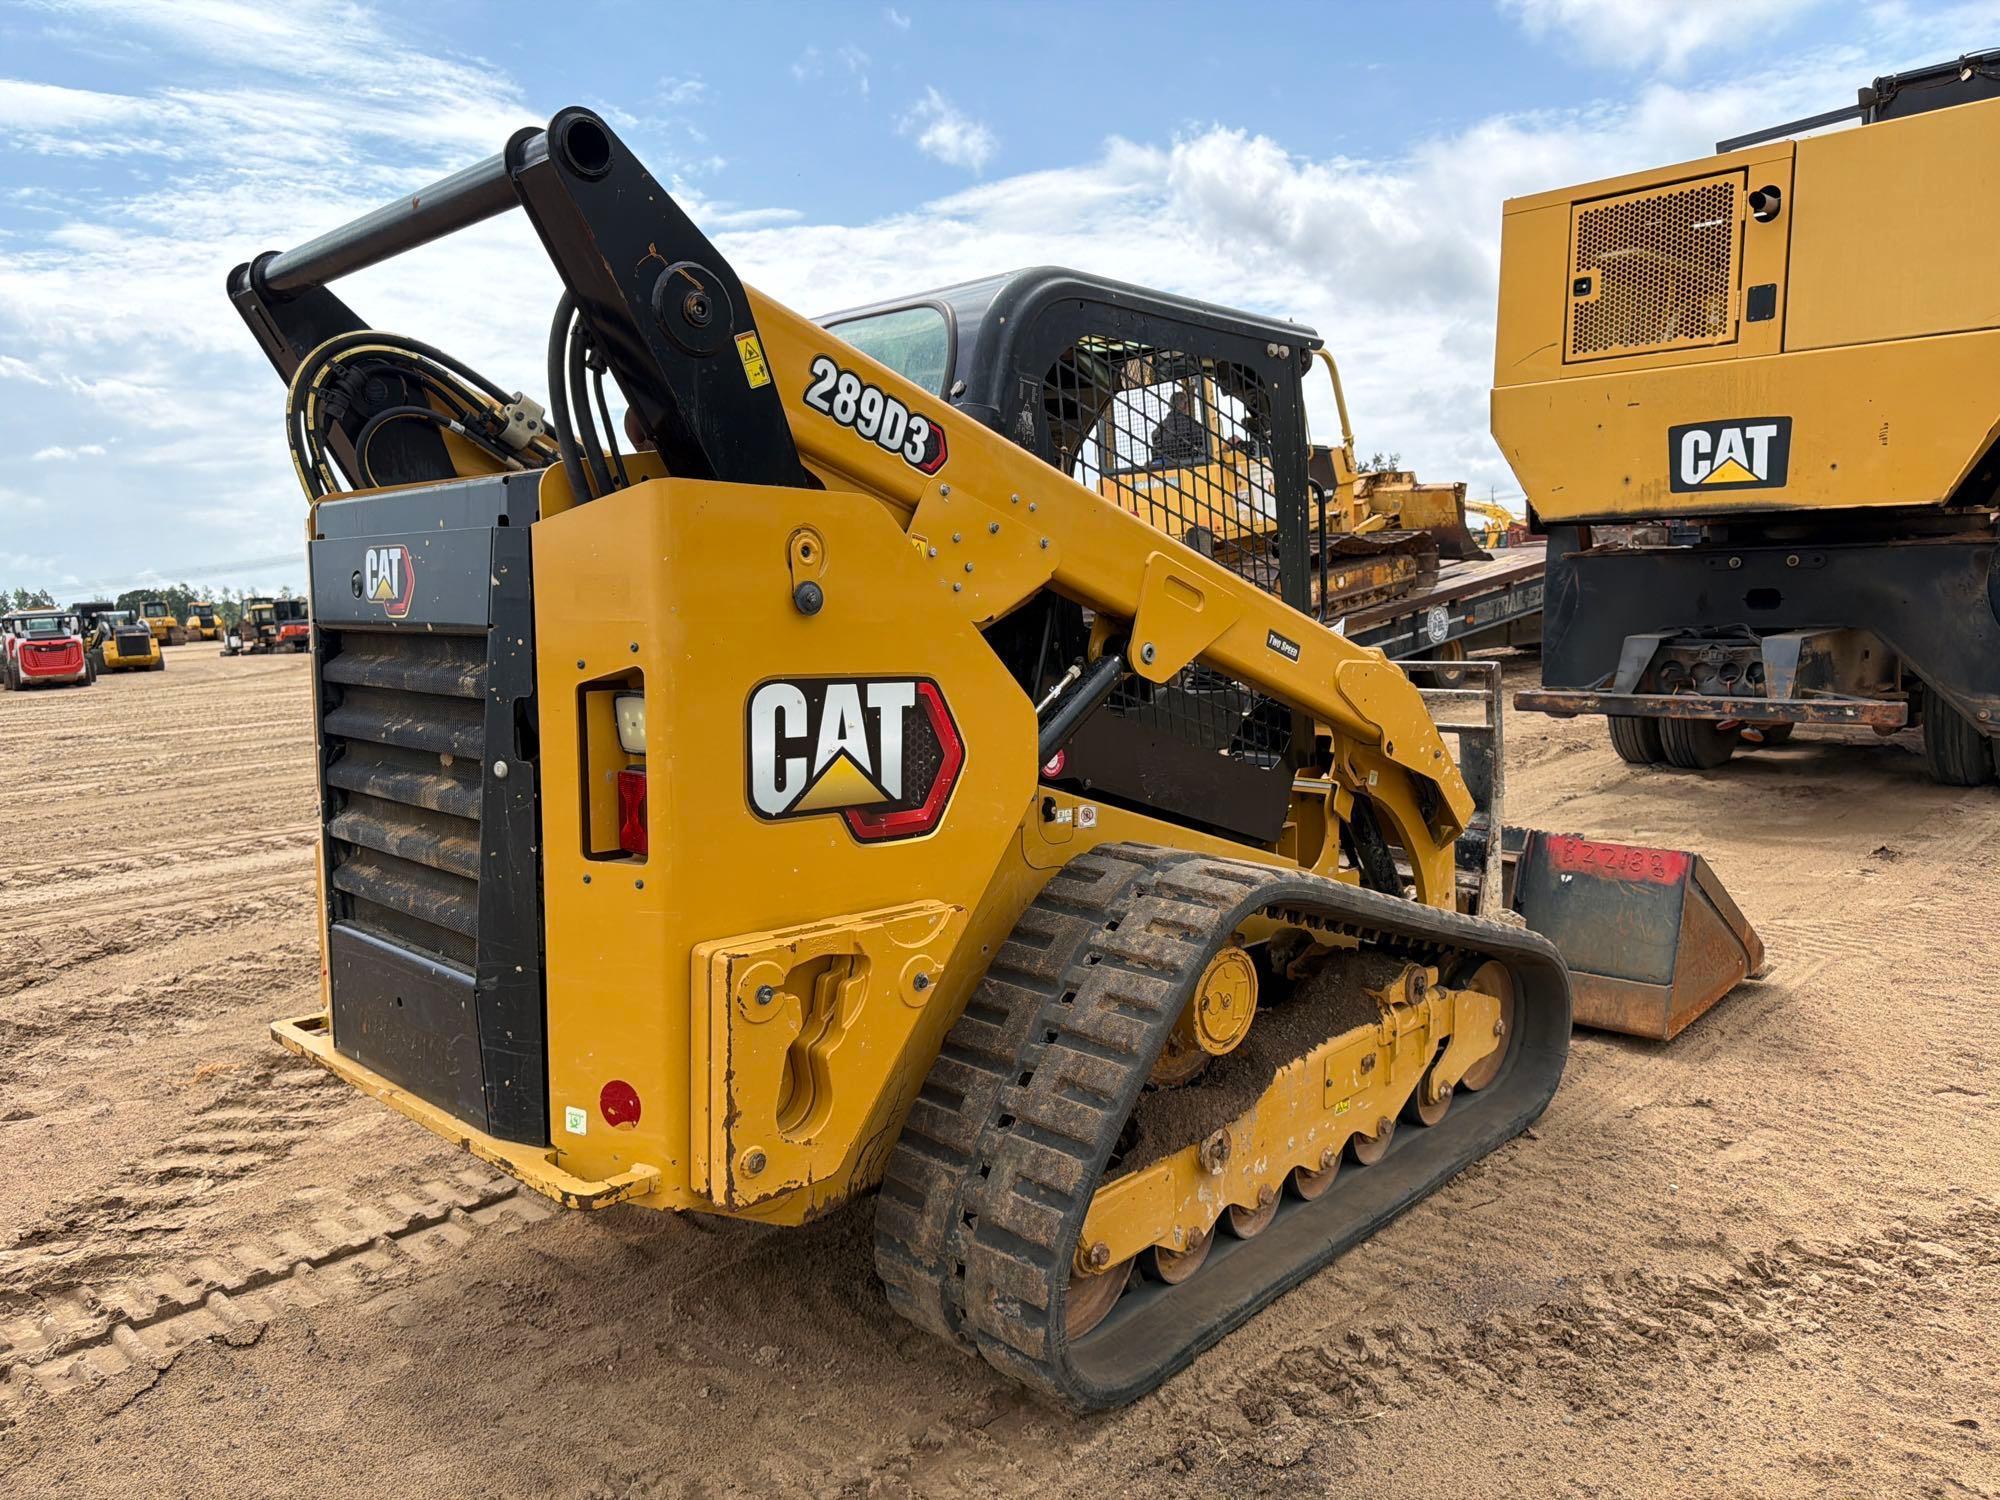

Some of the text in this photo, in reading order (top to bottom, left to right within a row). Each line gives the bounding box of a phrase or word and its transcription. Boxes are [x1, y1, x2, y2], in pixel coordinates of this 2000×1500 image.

[806, 358, 930, 464] 289D3
[1681, 425, 1777, 485] CAT
[365, 548, 402, 600] CAT
[751, 682, 916, 816] CAT
